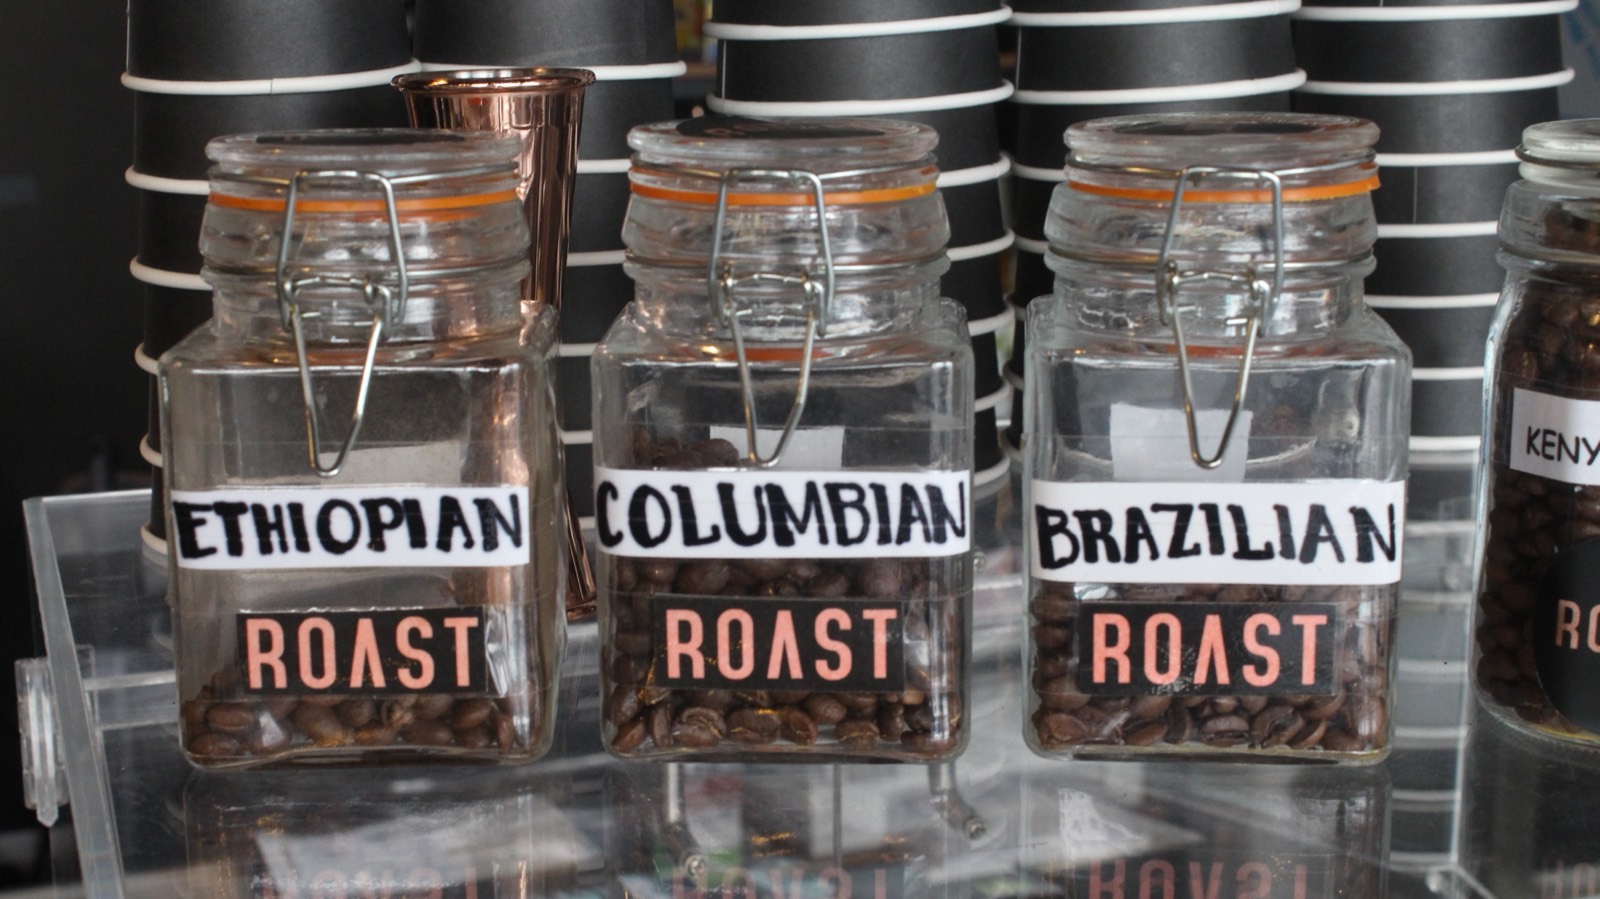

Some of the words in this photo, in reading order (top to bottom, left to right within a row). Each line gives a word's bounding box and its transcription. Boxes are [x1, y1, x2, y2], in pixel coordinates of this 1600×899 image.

[173, 494, 523, 558] ETHIOPIAN
[596, 480, 965, 548] COLUMBIAN
[1035, 502, 1396, 569] BRAZILIAN
[246, 616, 478, 690] ROAST
[666, 607, 898, 681] ROAST
[1092, 612, 1328, 687] ROAST
